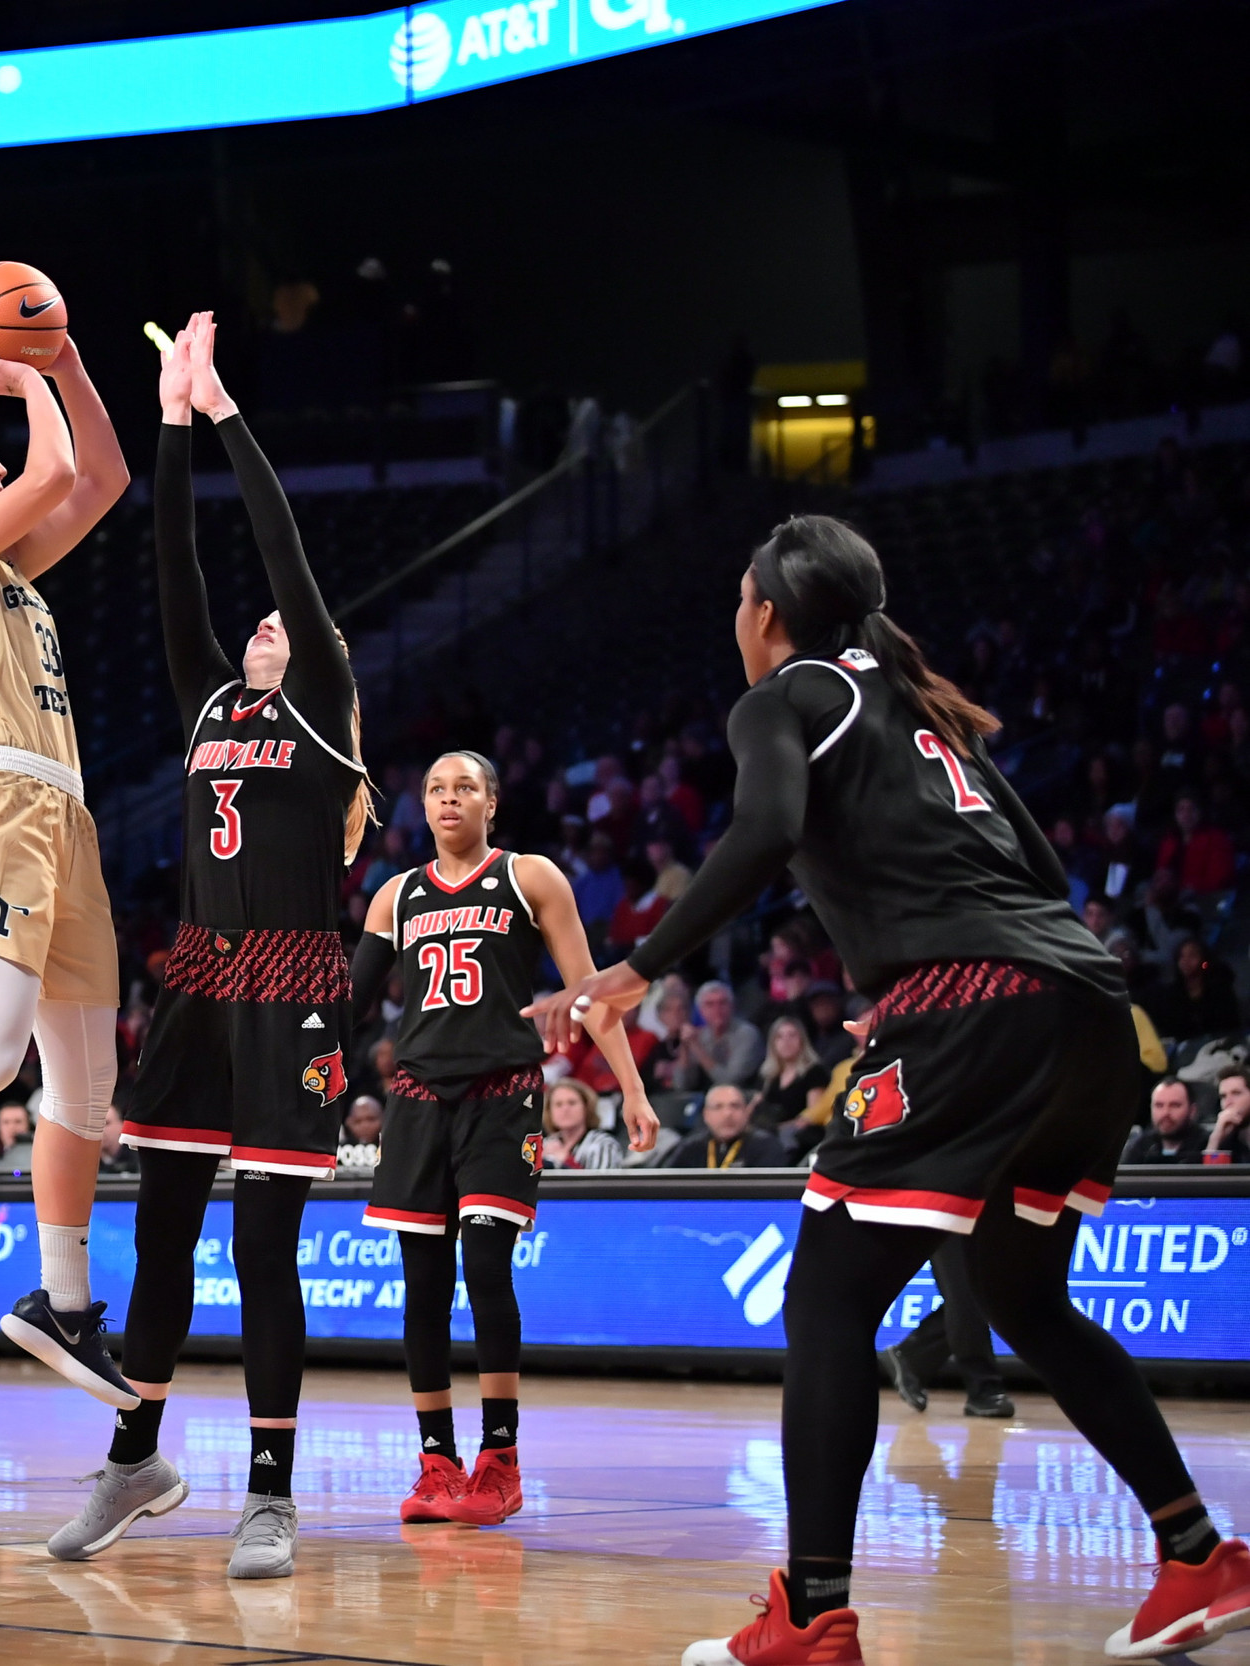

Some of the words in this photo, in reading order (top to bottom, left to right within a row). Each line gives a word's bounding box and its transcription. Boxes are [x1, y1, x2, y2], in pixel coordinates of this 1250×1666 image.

[456, 0, 558, 66] AT&T
[35, 622, 64, 678] 33
[914, 729, 992, 812] 2
[210, 780, 244, 860] 3
[403, 906, 513, 950] LOUISVILLE
[418, 938, 483, 1012] 25
[328, 1230, 403, 1266] Credi
[512, 1232, 548, 1268] of
